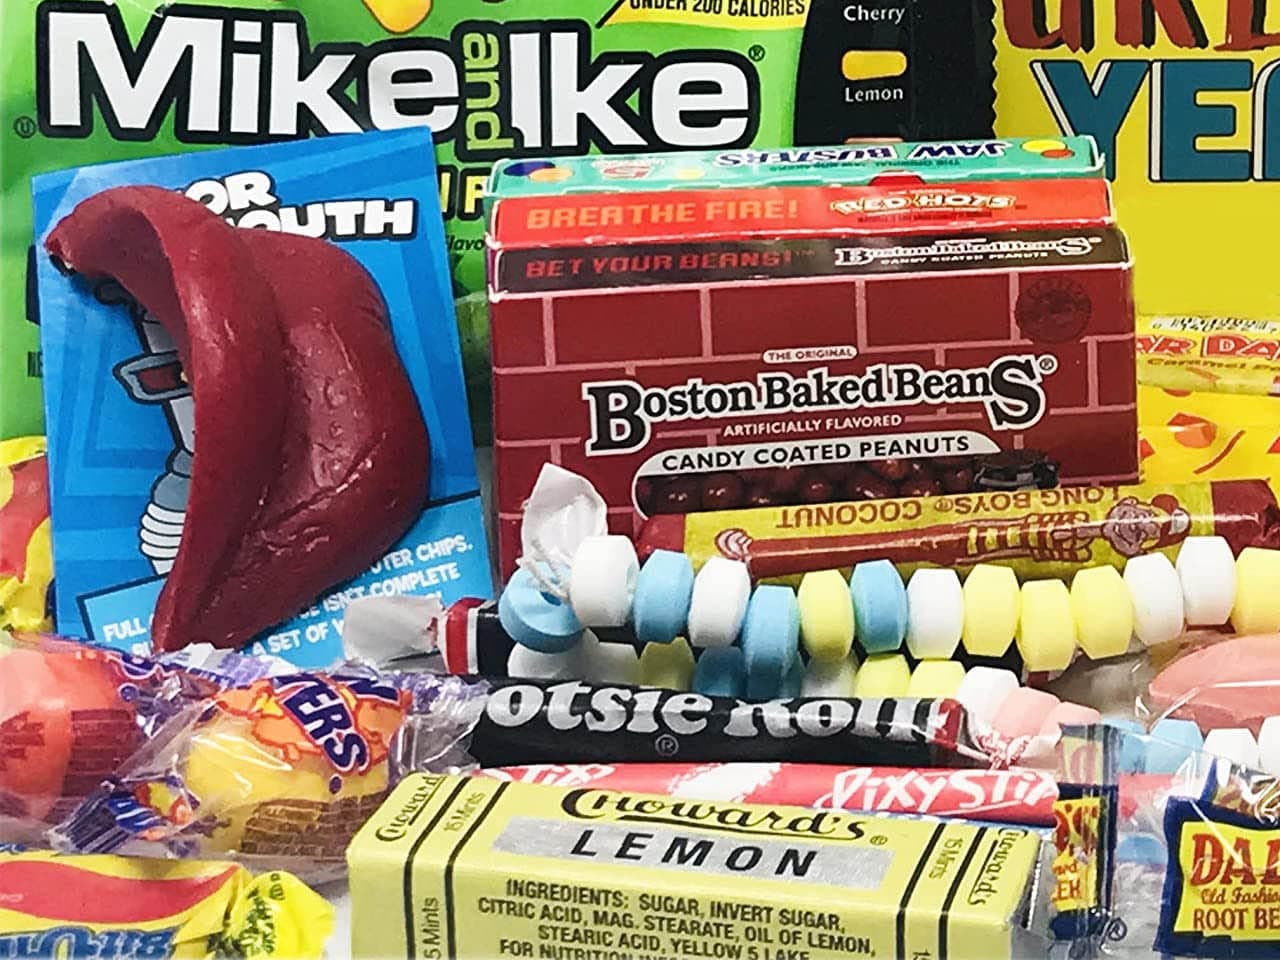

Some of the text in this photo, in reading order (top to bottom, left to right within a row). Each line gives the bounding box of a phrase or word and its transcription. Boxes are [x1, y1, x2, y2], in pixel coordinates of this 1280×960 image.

[843, 5, 906, 24] Cherry
[48, 11, 749, 151] Mike and Ike
[845, 86, 904, 103] Lemon
[910, 141, 1014, 161] JAW
[526, 199, 798, 230] BREATHE FIRE!
[525, 248, 792, 279] BET YOUR BEANS!
[768, 347, 855, 362] THE ORIGINAL
[588, 382, 755, 452] Boston
[762, 370, 886, 410] Baked
[723, 413, 903, 437] ARTIFICIALLY FLAVORED
[662, 436, 970, 472] CANDY COATED PEANUTS
[776, 499, 922, 529] COCONUT
[955, 490, 1032, 512] BOYS
[416, 534, 474, 561] CHIPS.
[367, 564, 461, 599] COMPLETE
[103, 616, 148, 642] FULL
[267, 629, 301, 655] SET
[305, 621, 330, 642] OF
[570, 828, 820, 879] LEMON
[506, 879, 847, 933] INGREDIENTS: SUGAR, INVERT SUGAR,
[1202, 888, 1226, 906] Old
[421, 897, 441, 942] Mints
[478, 897, 877, 957] CITRIC ACID, MAG. STEARATE, OIL OF LEMON,
[1193, 908, 1248, 931] ROOT
[500, 939, 535, 957] FOR
[538, 924, 613, 948] STEARIC
[617, 933, 668, 953] ACID,
[671, 939, 745, 960] YELLOW
[748, 946, 760, 960] 5
